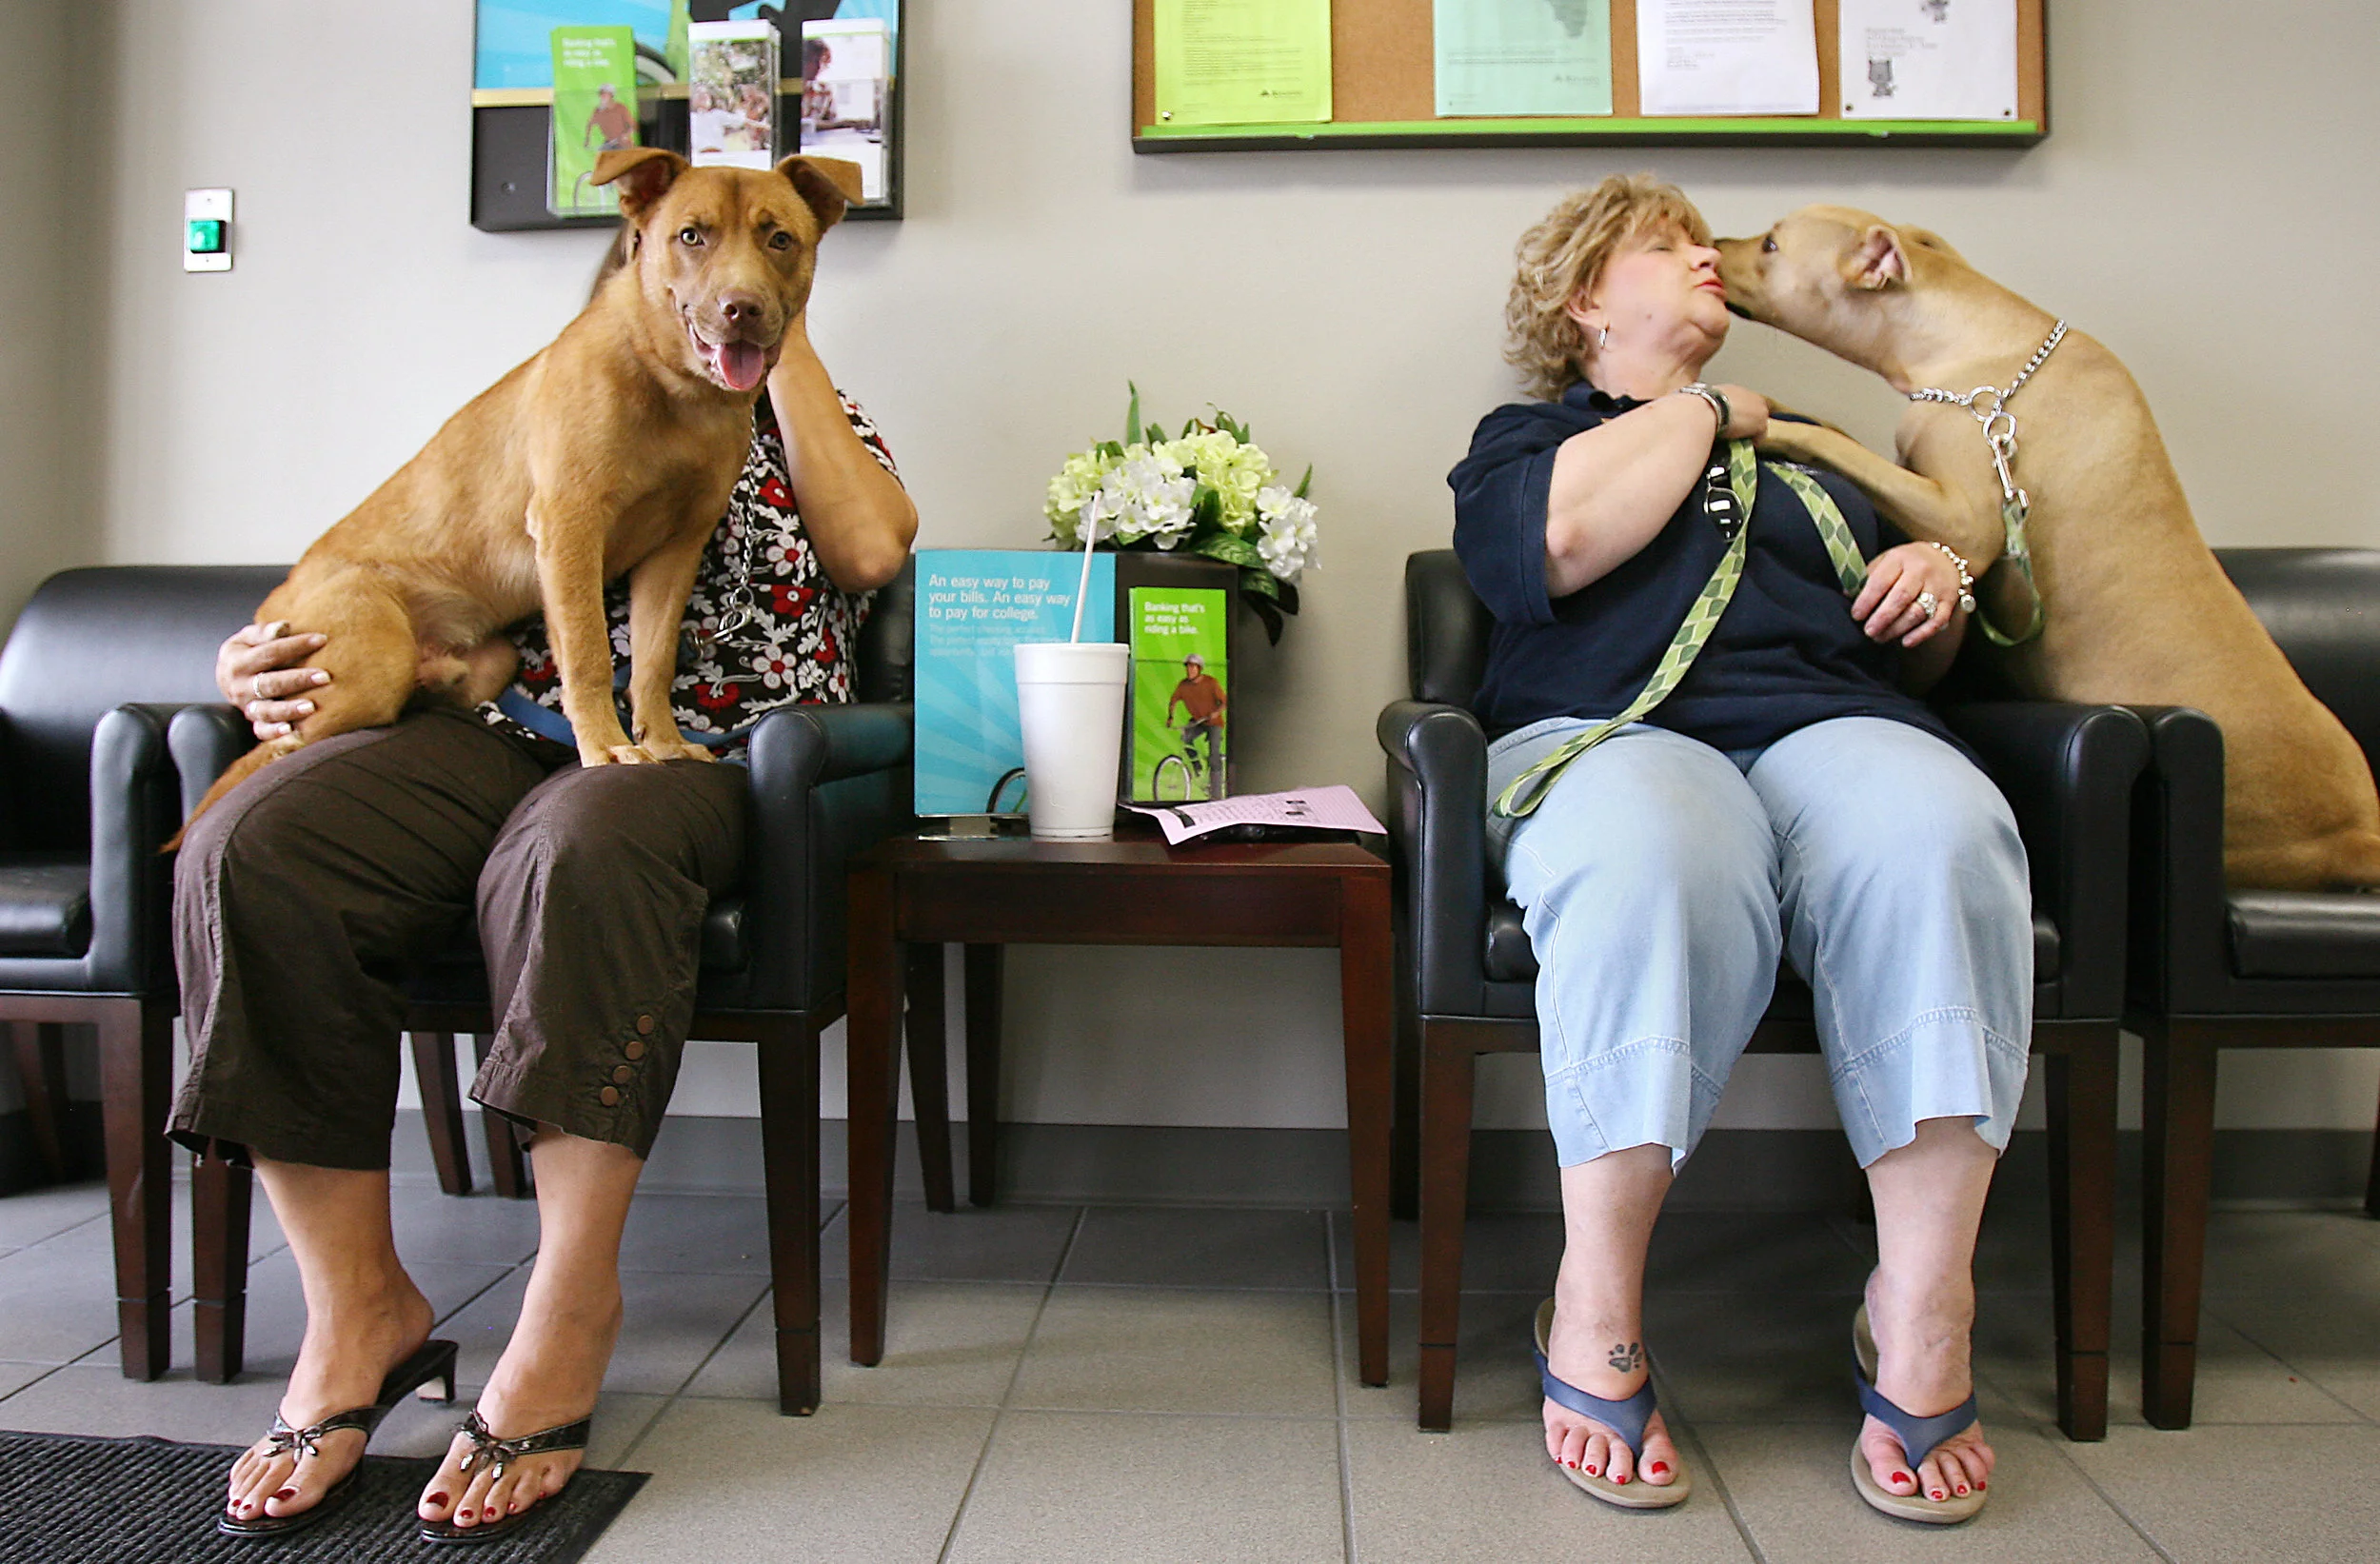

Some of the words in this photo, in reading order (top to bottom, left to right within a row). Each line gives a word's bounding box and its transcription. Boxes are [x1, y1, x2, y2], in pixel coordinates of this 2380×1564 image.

[929, 574, 945, 587] An
[951, 577, 979, 590] easy
[982, 578, 1008, 590] way
[1013, 576, 1024, 588] to
[1029, 579, 1050, 591] pay
[929, 592, 956, 604] your
[961, 591, 988, 604] bills.
[993, 591, 1010, 604] An
[1015, 594, 1042, 606] easy
[1046, 595, 1070, 607] way
[929, 606, 941, 618] to
[945, 608, 967, 621] pay
[972, 605, 988, 619] for
[992, 607, 1039, 622] college.
